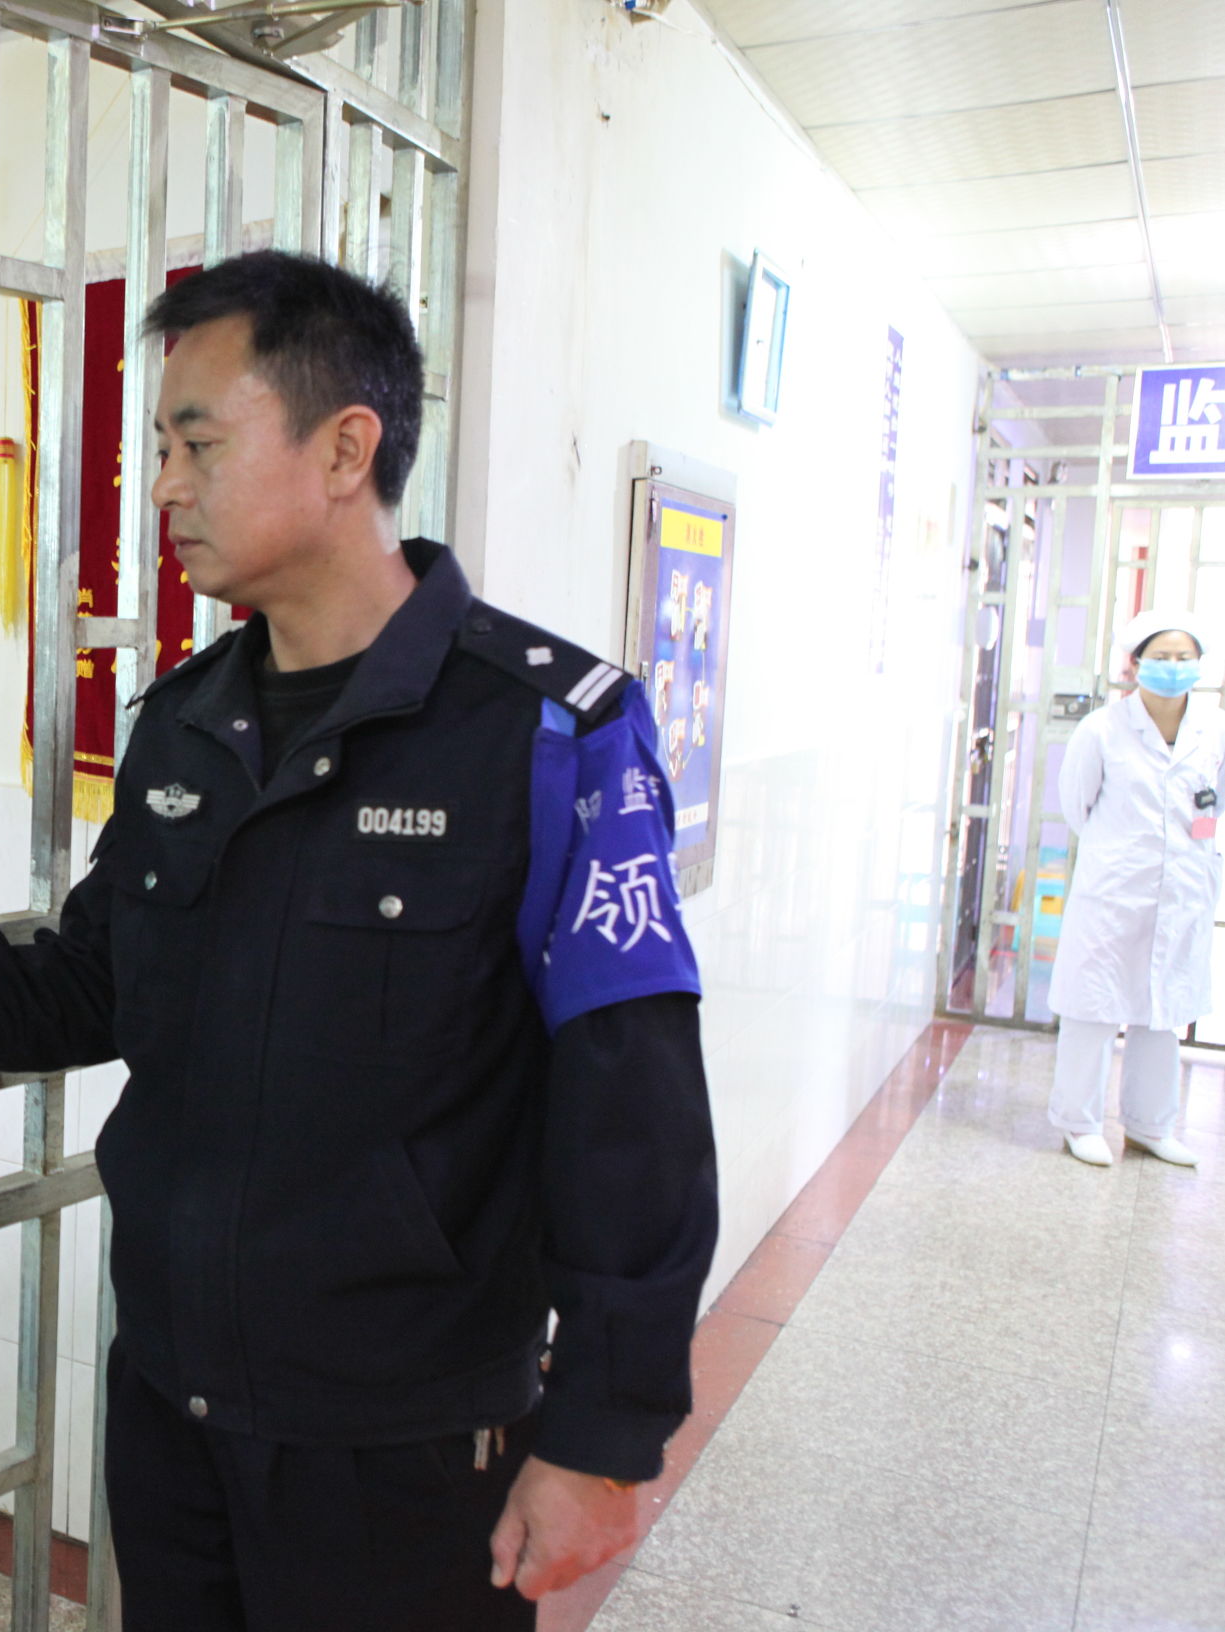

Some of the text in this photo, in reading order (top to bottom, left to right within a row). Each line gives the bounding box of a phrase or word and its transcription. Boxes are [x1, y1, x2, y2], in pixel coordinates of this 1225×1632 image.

[1149, 377, 1225, 464] 监
[357, 806, 447, 836] 004199
[572, 853, 672, 952] 领
